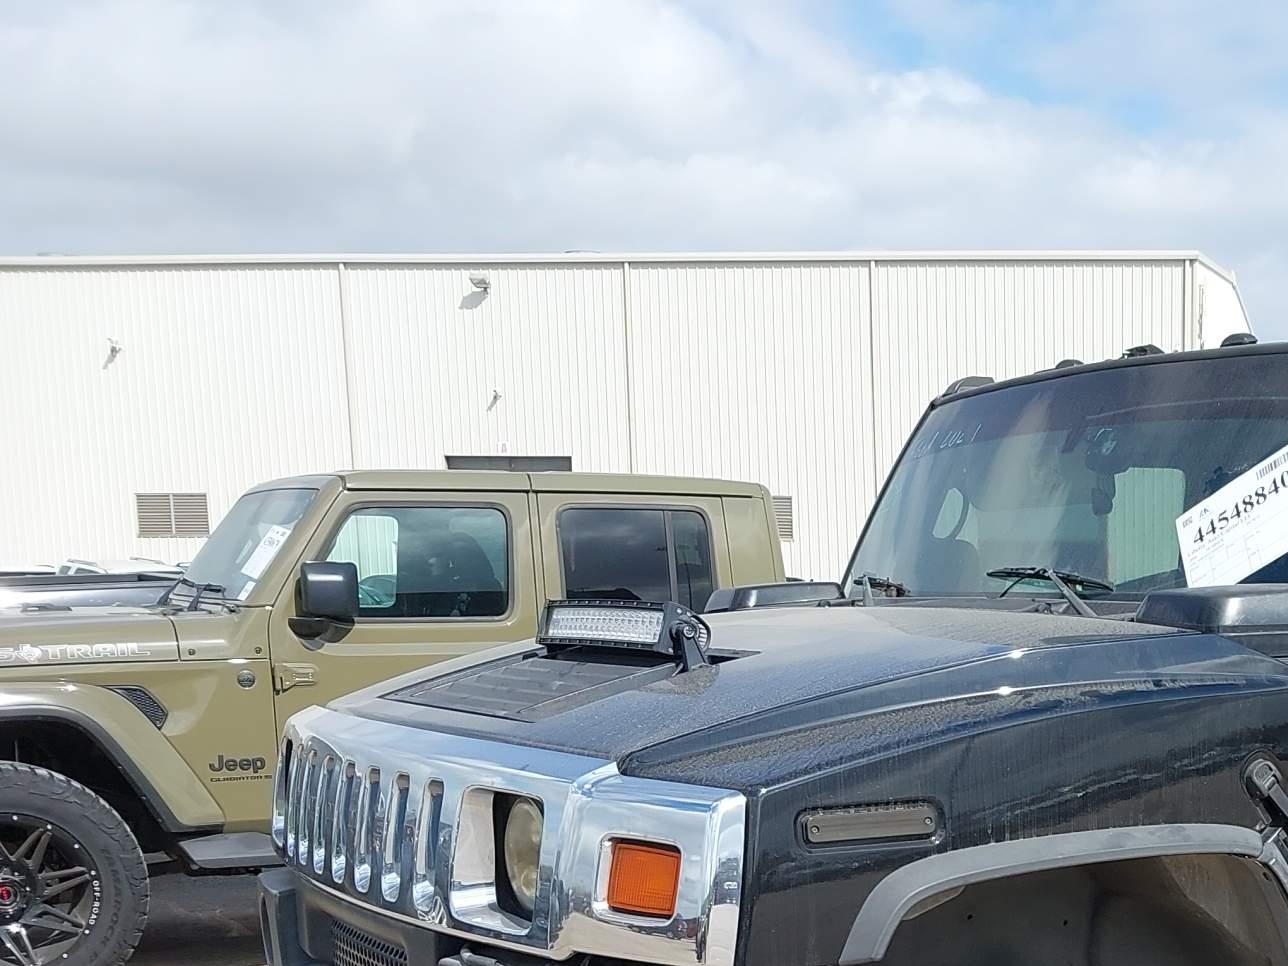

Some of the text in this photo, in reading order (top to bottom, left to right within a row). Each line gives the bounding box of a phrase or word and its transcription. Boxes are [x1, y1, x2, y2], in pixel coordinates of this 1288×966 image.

[38, 642, 151, 660] TRAIL
[208, 754, 266, 774] Jeep
[88, 880, 101, 926] OFF-ROAD
